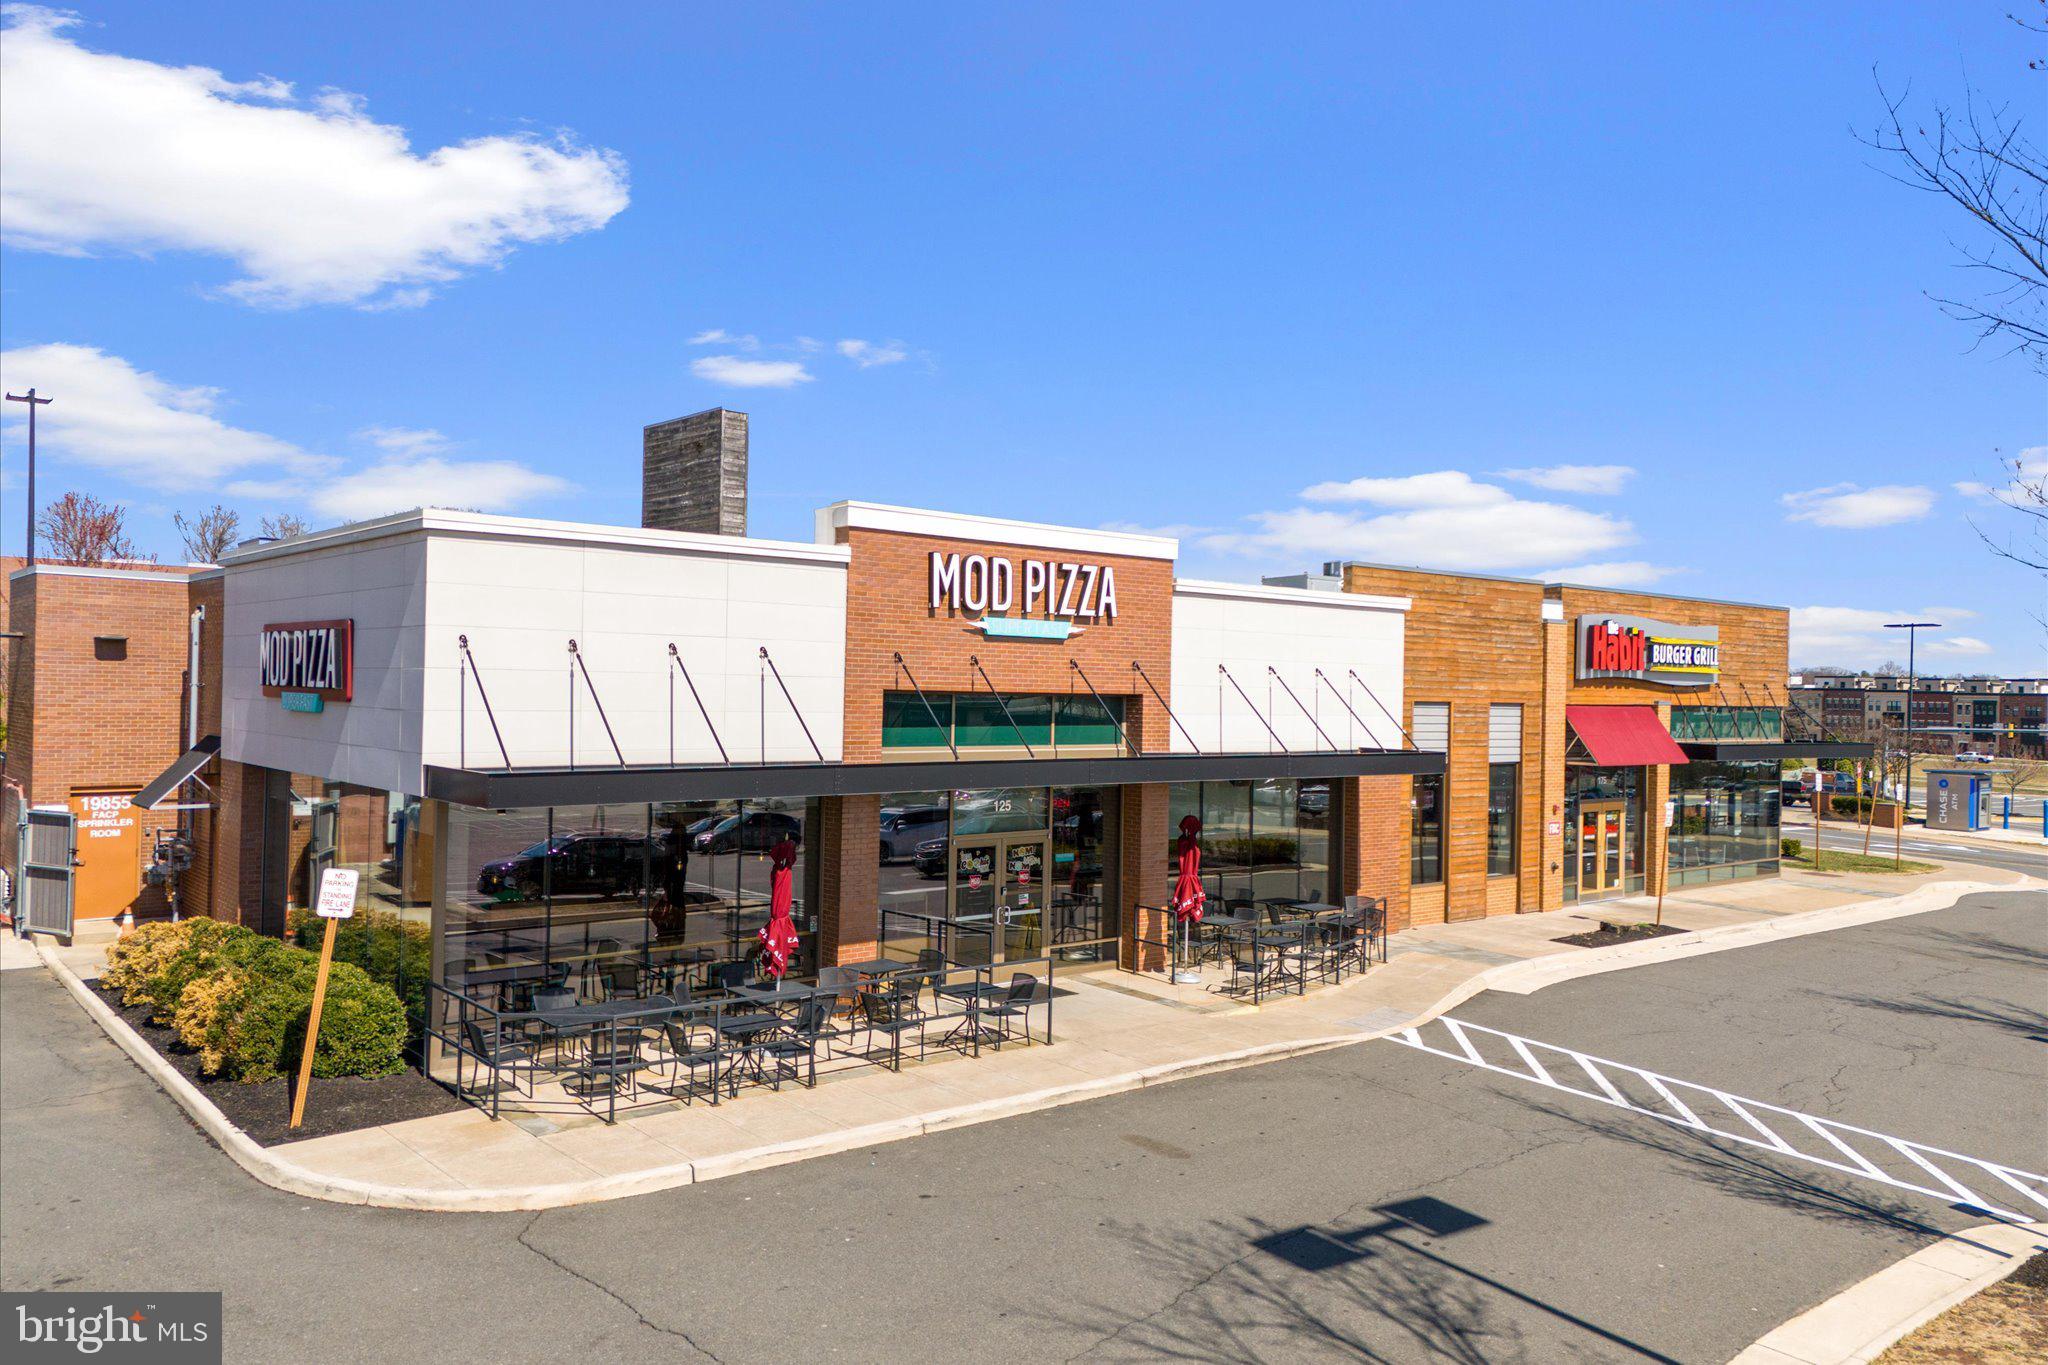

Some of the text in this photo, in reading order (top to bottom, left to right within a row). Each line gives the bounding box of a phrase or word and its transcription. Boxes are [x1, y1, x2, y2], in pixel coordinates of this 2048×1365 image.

[930, 552, 1118, 618] MOD PIZZA
[1593, 624, 1645, 671] Habit
[1652, 644, 1719, 665] BURGER GRILL
[260, 628, 336, 688] MOD PIZZA
[81, 795, 132, 811] 19855
[994, 799, 1012, 812] 125
[1940, 790, 1948, 824] CHASE
[92, 810, 119, 819] FACP
[78, 819, 133, 828] SPRINKLER
[90, 829, 121, 838] ROOM
[325, 879, 354, 888] PARKING
